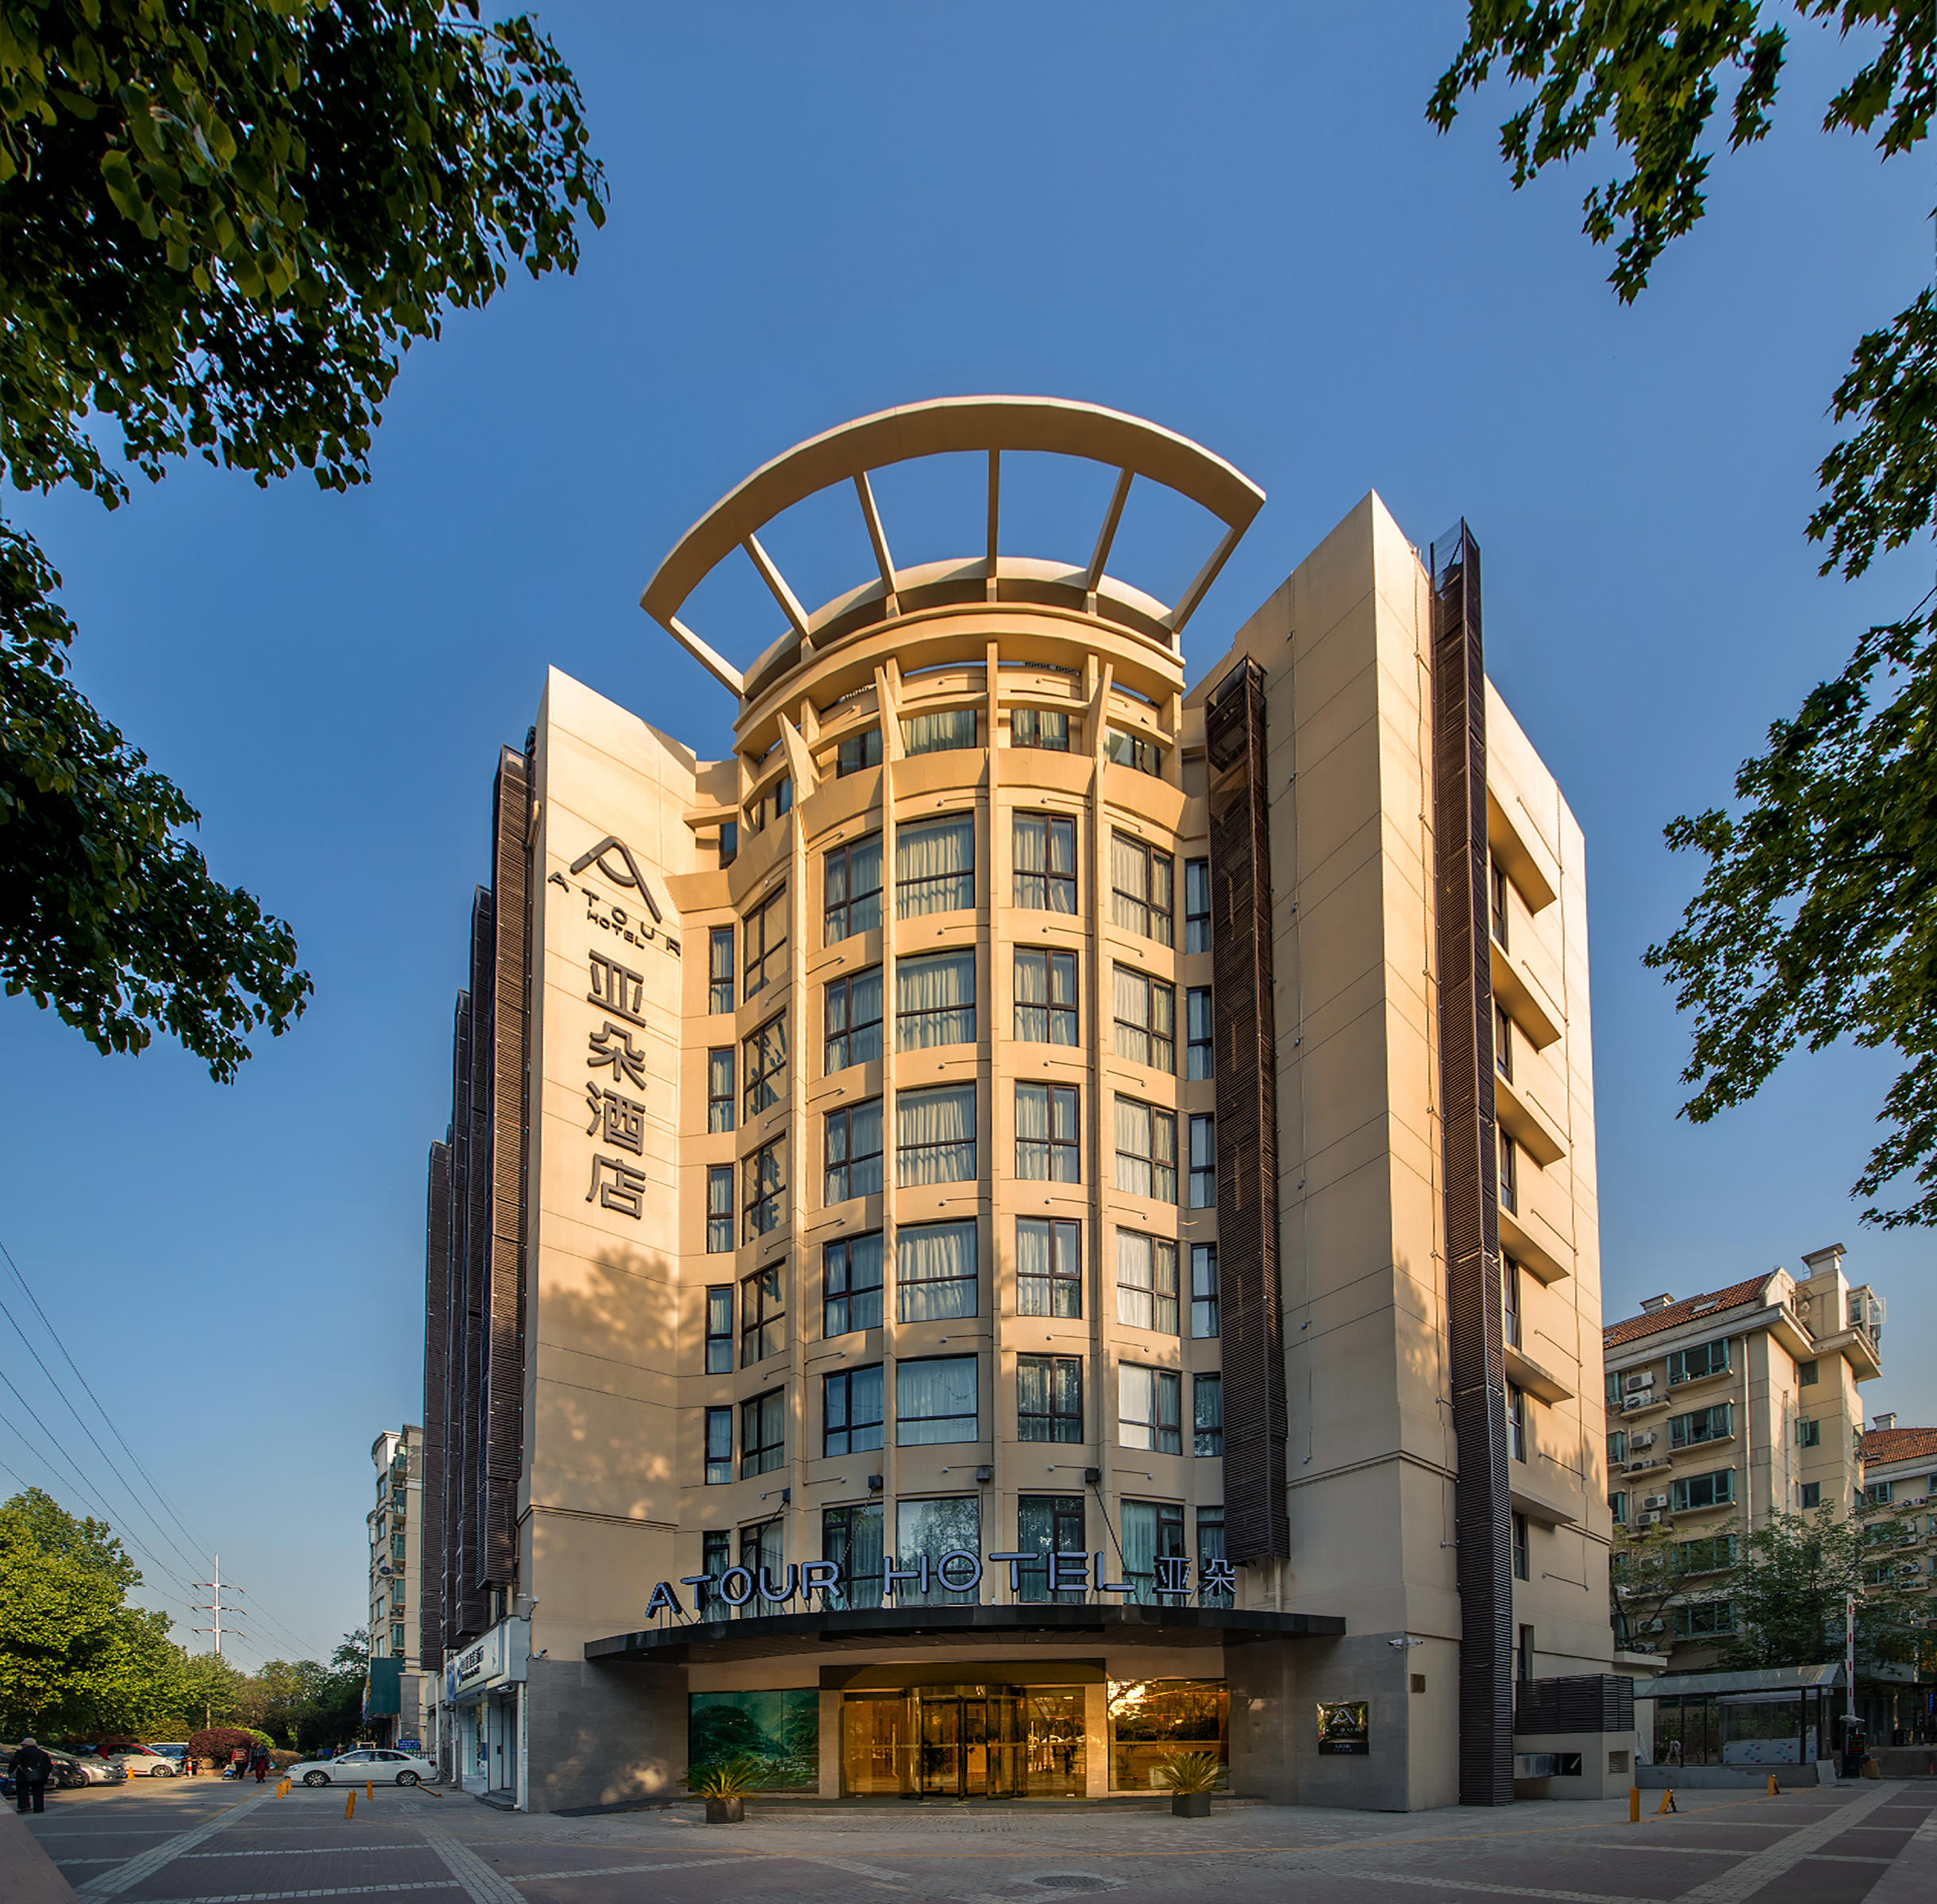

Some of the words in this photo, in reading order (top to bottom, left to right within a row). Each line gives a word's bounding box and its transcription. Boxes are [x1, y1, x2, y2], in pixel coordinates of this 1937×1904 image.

[548, 871, 681, 957] ATOUR
[587, 910, 645, 950] HOTEL
[587, 948, 646, 1220] 亚朵酒店
[645, 1560, 844, 1620] ATOUR
[884, 1548, 1137, 1595] HOTEL
[1153, 1556, 1237, 1596] 亚朵
